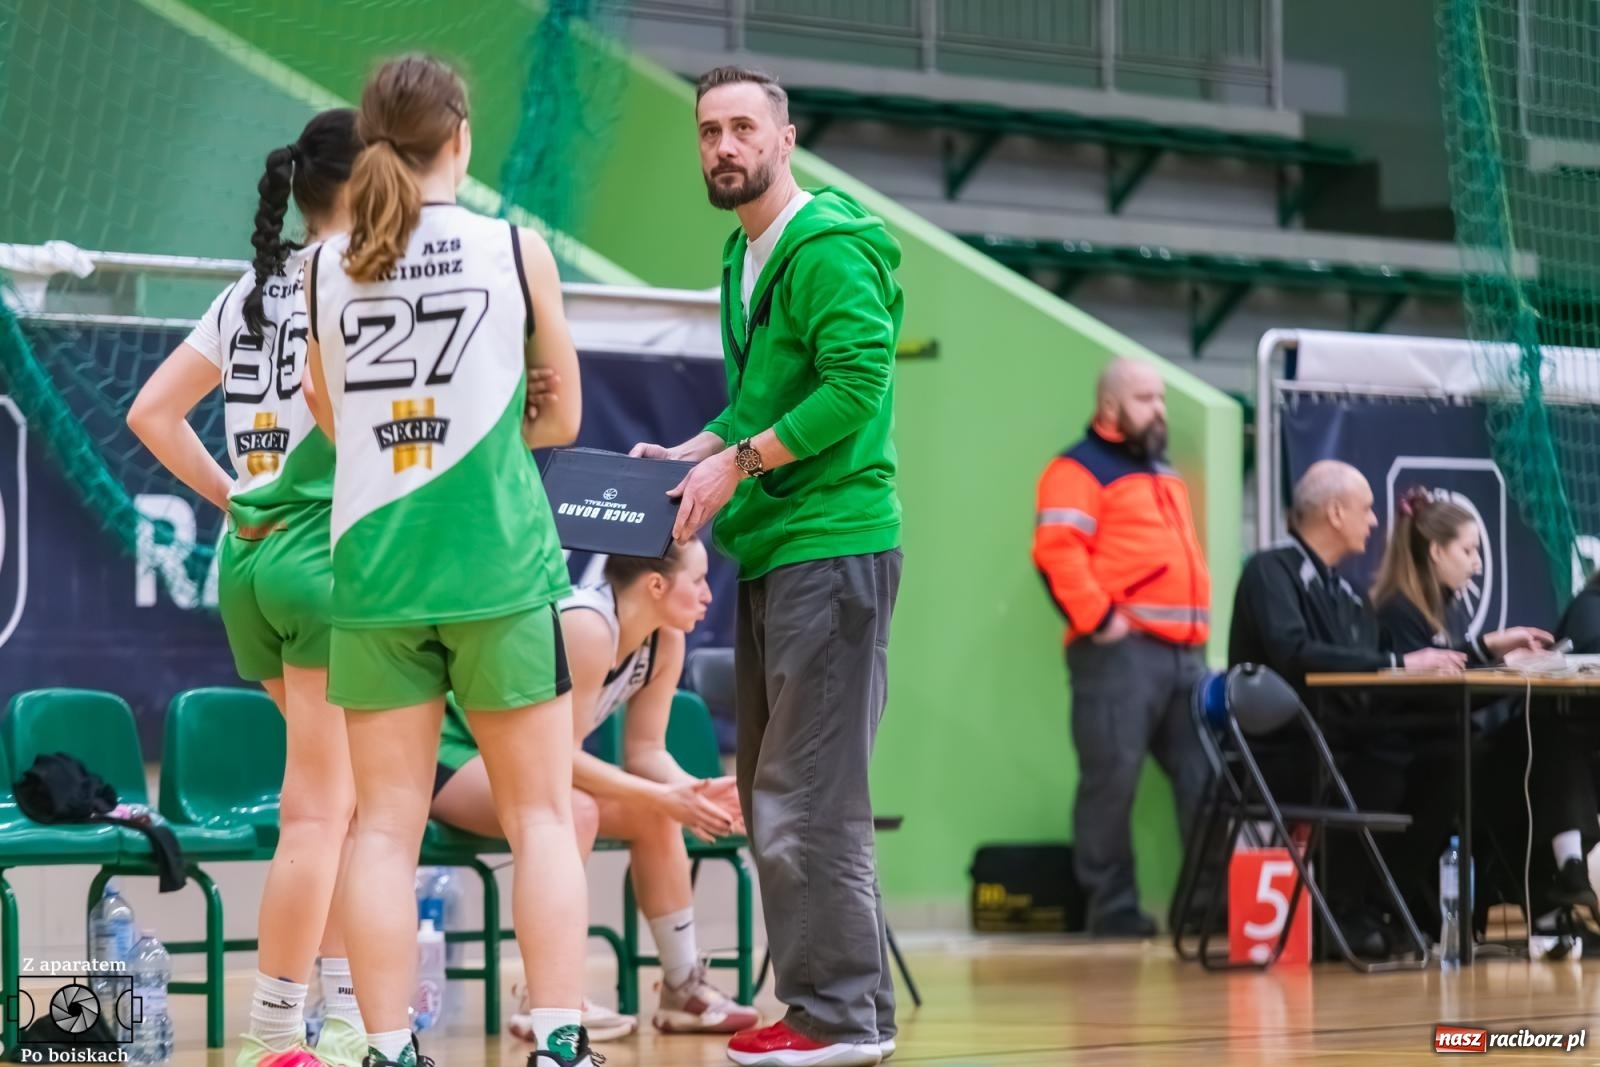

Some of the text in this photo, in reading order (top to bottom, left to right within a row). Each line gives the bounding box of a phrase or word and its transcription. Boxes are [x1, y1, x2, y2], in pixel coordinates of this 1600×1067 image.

[422, 238, 461, 256] AZS
[378, 259, 463, 281] CIBÓRZ
[340, 288, 489, 393] 27
[239, 431, 289, 452] SEGET
[379, 420, 446, 446] SEGET
[558, 502, 645, 524] COACH BOARD
[584, 499, 627, 510] BASKETBALL
[133, 493, 219, 609] R
[1244, 861, 1294, 940] 5
